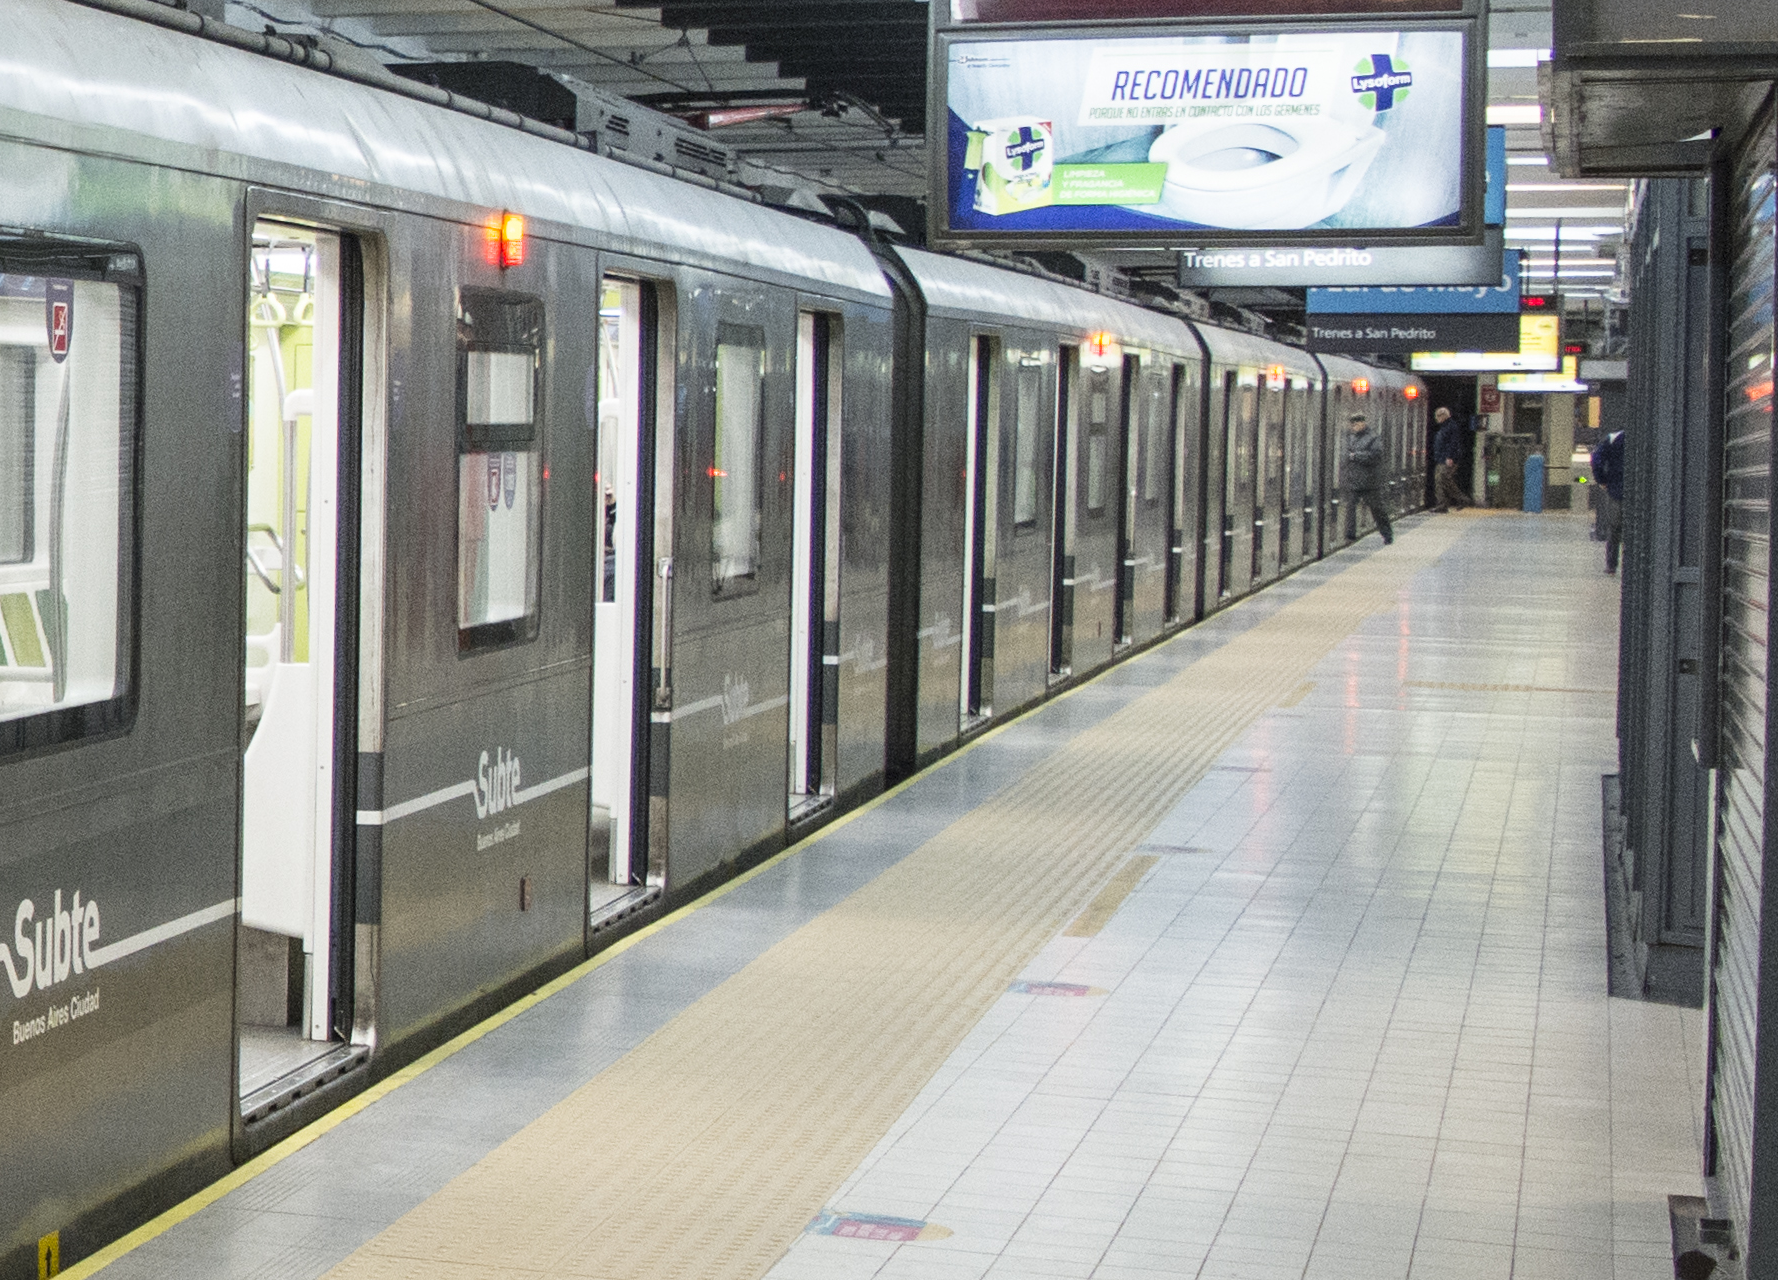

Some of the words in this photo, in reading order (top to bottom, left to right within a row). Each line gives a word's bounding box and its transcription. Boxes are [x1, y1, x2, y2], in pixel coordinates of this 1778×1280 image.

[1111, 66, 1309, 101] RECOMENDADO
[1351, 72, 1411, 91] Lysoform
[1183, 251, 1245, 268] Trenes
[1248, 254, 1260, 267] a
[1264, 250, 1299, 267] San
[1303, 248, 1373, 267] Pedrito
[1311, 327, 1353, 339] Trenes
[1354, 331, 1362, 339] a
[1365, 327, 1390, 339] San
[1391, 327, 1437, 339] Pedrito
[477, 746, 521, 819] Subte
[14, 888, 101, 998] Subte
[12, 1015, 46, 1045] Buenos
[47, 1004, 70, 1031] Aires
[70, 986, 100, 1020] Ciudad
